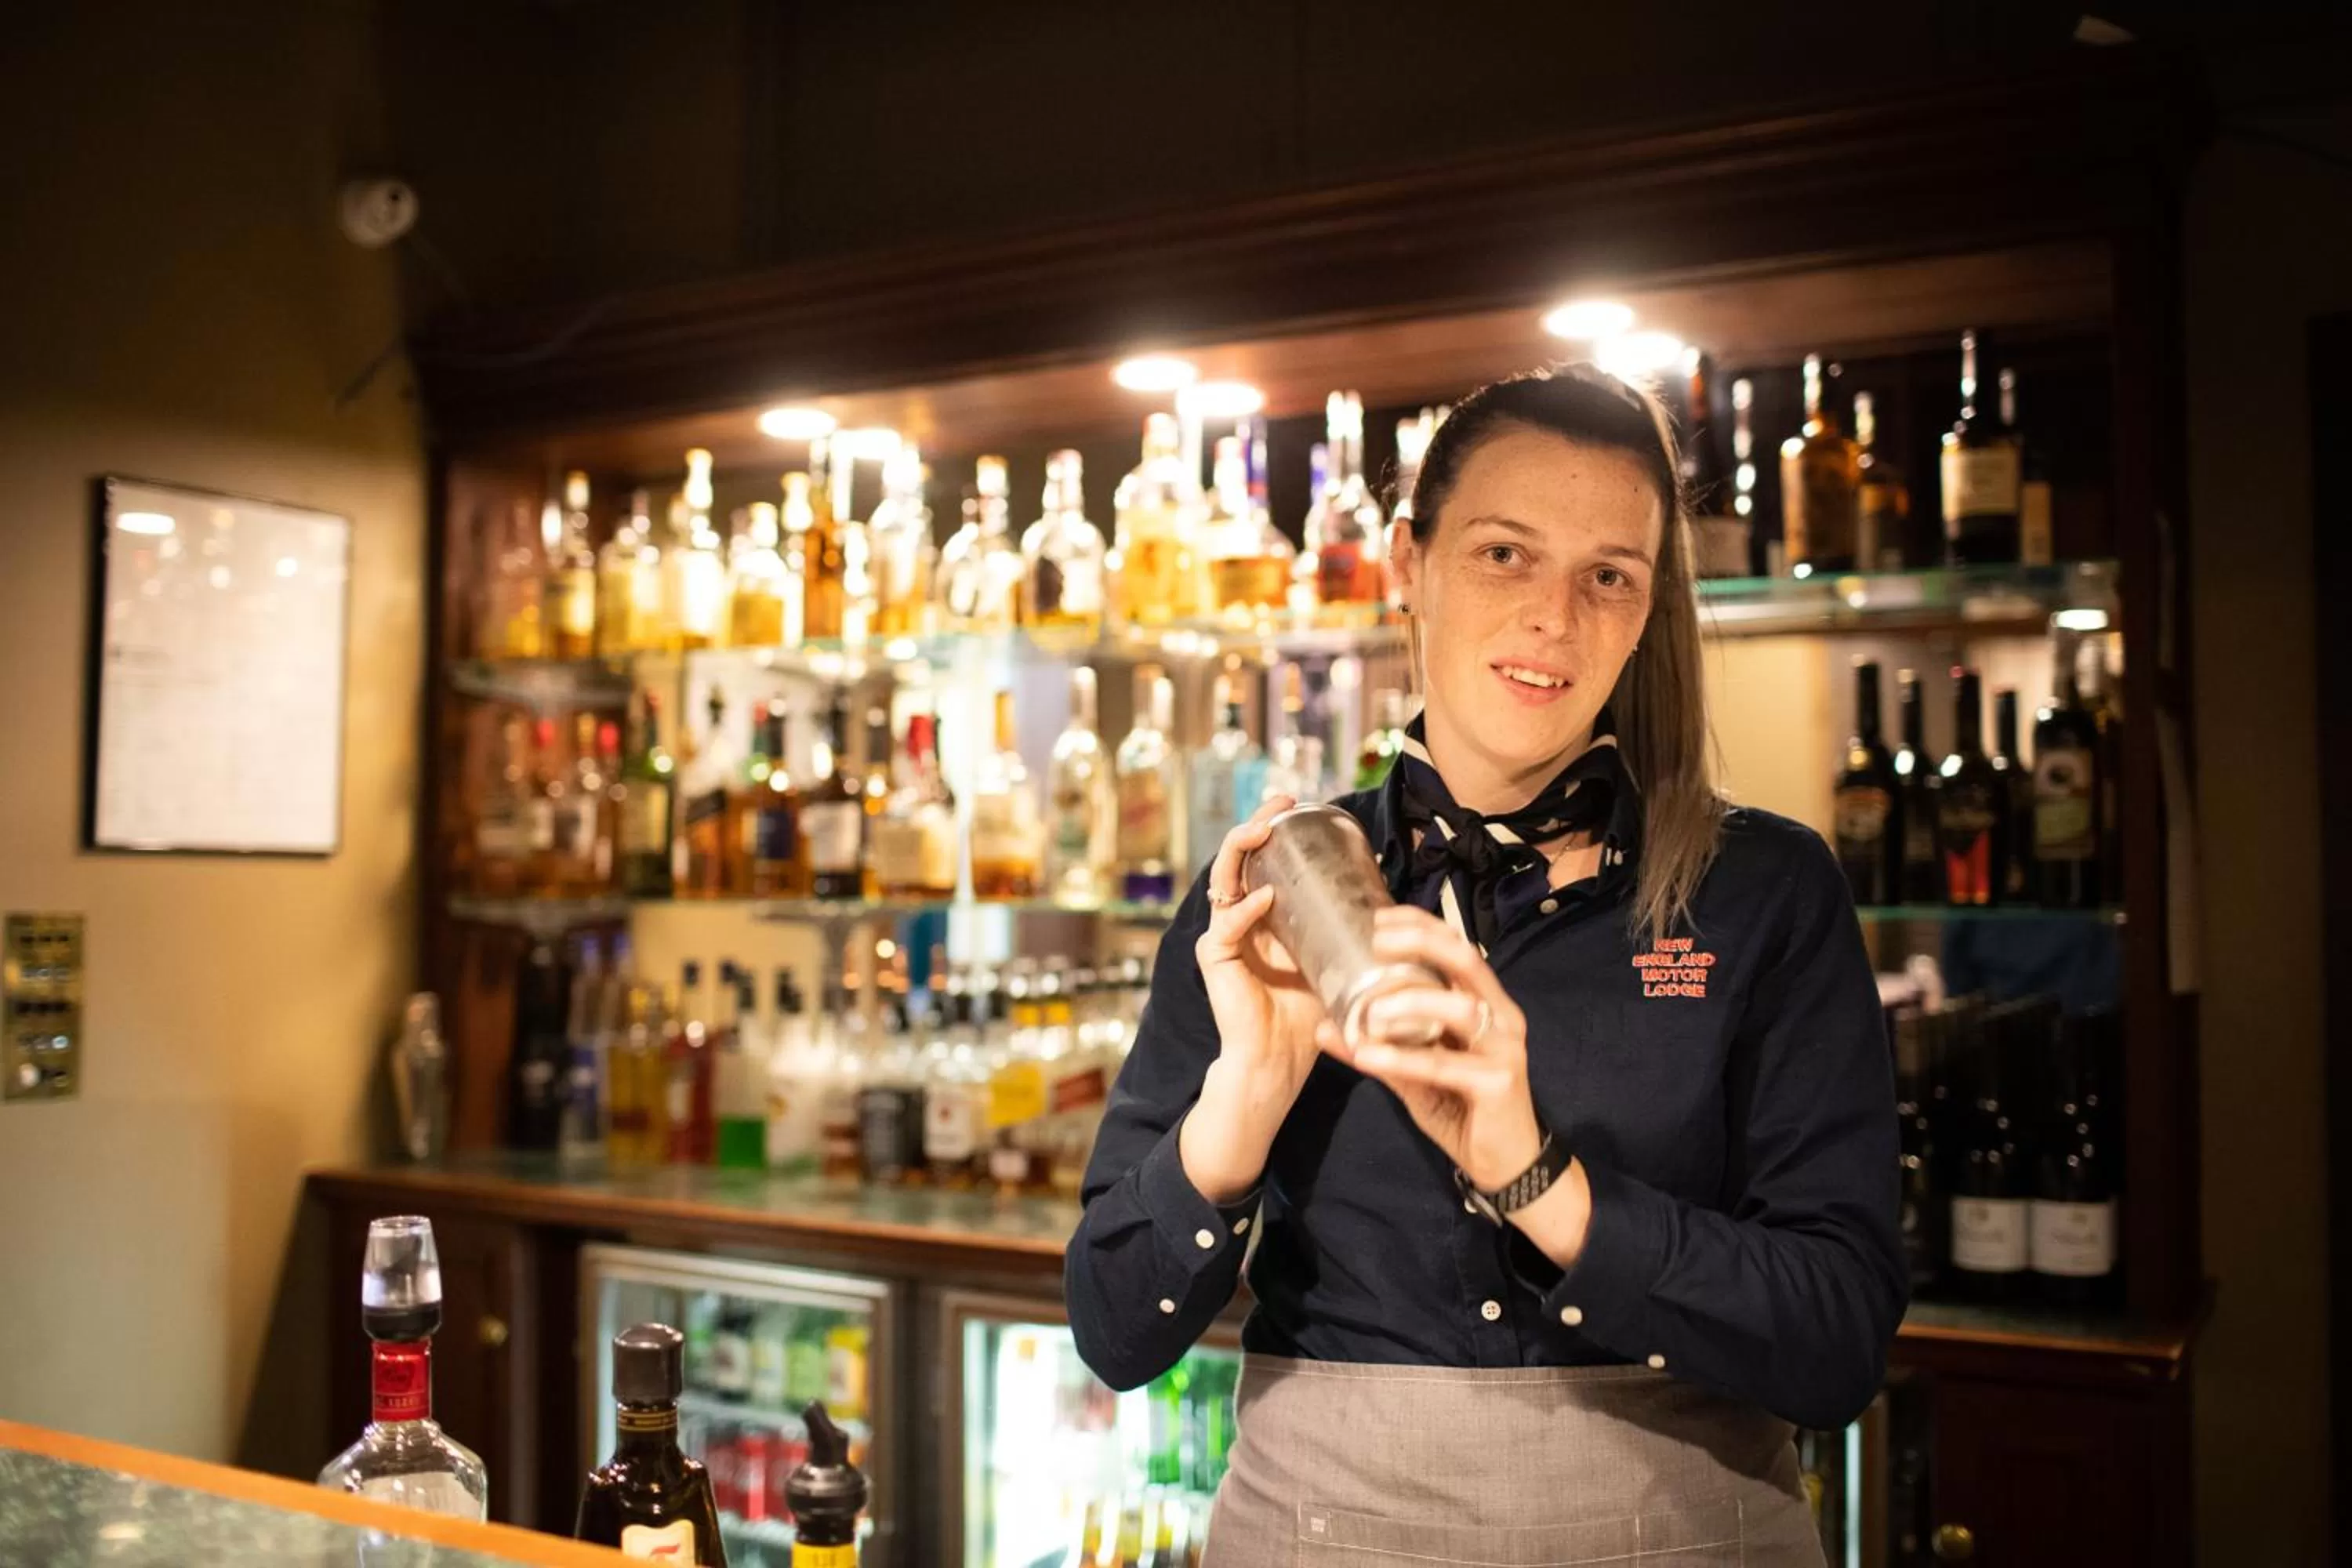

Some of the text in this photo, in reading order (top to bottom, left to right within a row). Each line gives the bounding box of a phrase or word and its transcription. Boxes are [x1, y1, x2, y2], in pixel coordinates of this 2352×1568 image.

[1653, 938, 1693, 952] NEW
[1632, 953, 1715, 967] ENGLAND
[1642, 968, 1708, 982] MOTOR
[1643, 982, 1706, 997] LODGE
